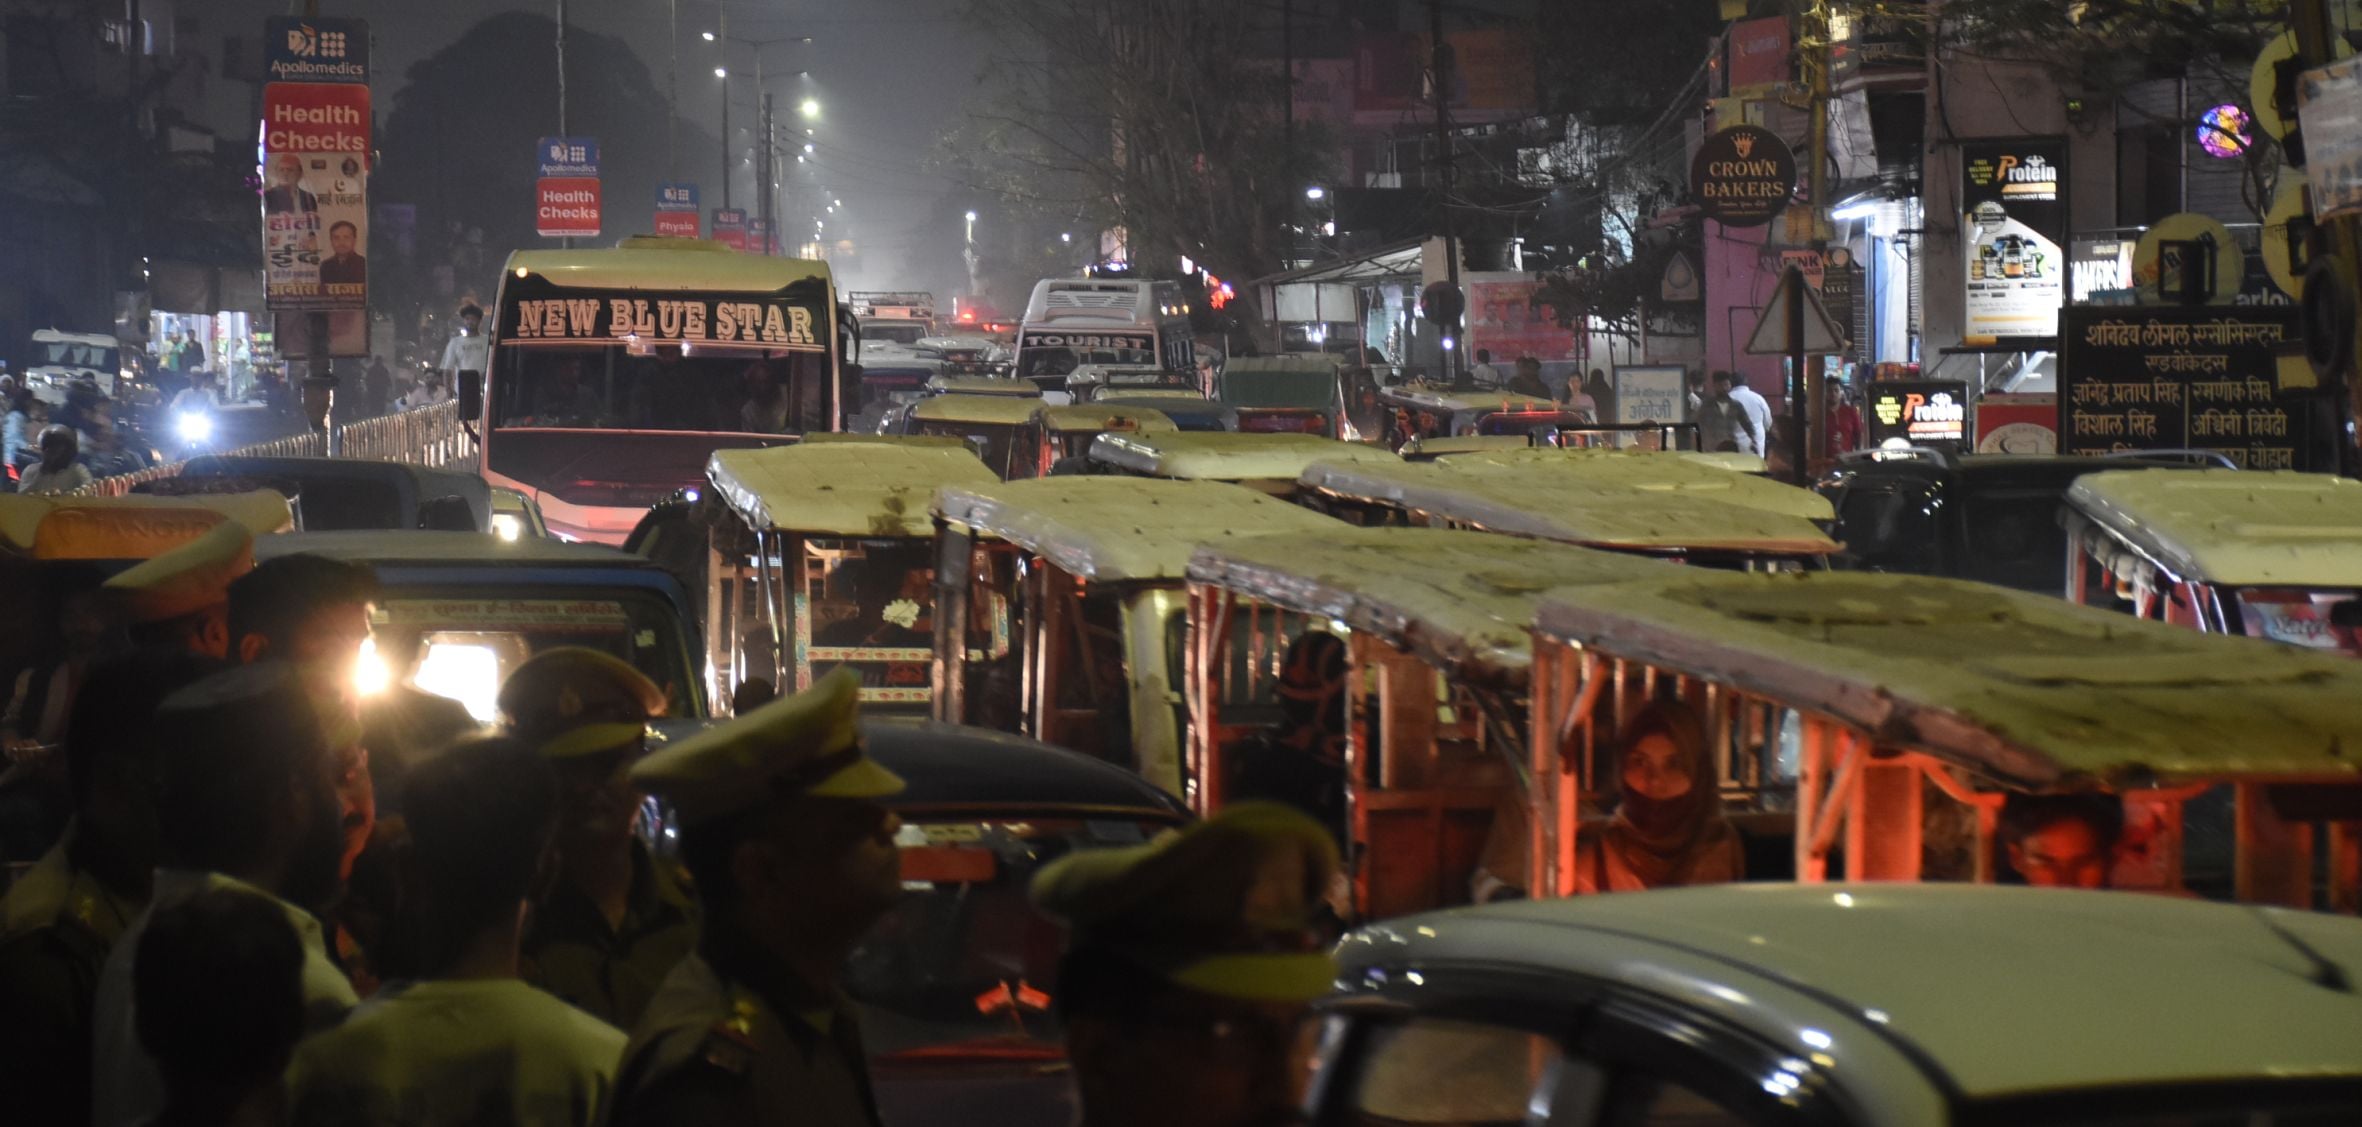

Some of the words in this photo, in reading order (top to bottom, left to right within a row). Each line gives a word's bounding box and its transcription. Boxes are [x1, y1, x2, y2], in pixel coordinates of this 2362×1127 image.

[271, 60, 364, 79] Apollomedics
[275, 104, 359, 124] Health
[269, 131, 365, 150] Checks
[541, 164, 597, 176] Apollomedics
[1709, 159, 1776, 177] CROWN
[1997, 155, 2056, 182] Protein
[543, 191, 595, 203] Health
[1703, 181, 1784, 197] BAKERS
[269, 211, 321, 231] होली
[540, 206, 598, 219] Checks
[660, 221, 694, 232] Physio
[269, 244, 322, 268] ईद
[517, 299, 599, 337] NEW
[609, 299, 707, 339] BLUE
[716, 302, 814, 343] STAR
[1025, 335, 1146, 349] TOURIST
[2085, 319, 2141, 346] शनिदेव
[2143, 319, 2190, 346] लीगल
[2112, 383, 2151, 402] प्रताप
[2154, 376, 2181, 407] सिंह
[2072, 408, 2125, 436] विशाल
[2127, 408, 2157, 440] सिंह
[2246, 408, 2288, 436] त्रिवेदी
